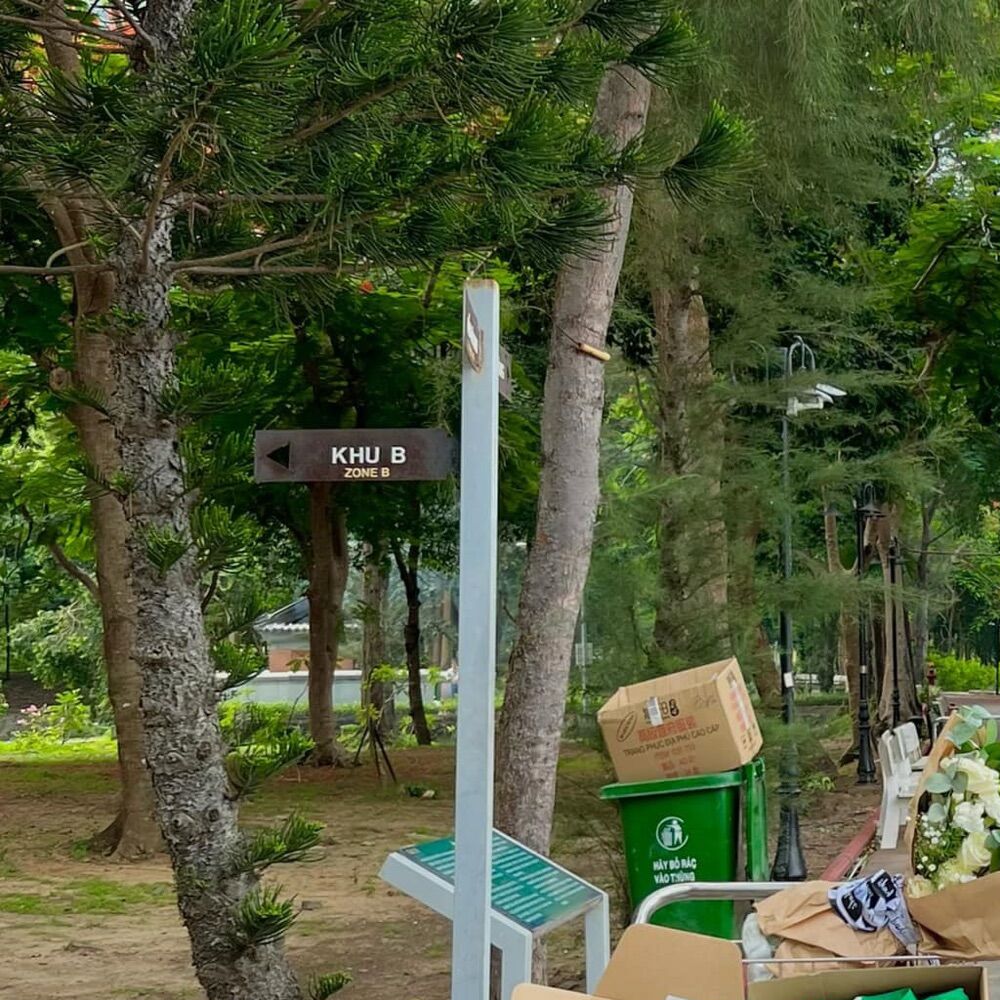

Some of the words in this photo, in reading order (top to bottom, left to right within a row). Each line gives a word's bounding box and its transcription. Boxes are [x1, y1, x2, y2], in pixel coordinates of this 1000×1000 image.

[331, 446, 380, 464] KHU
[391, 446, 406, 464] B
[344, 468, 379, 478] ZONE
[381, 467, 391, 477] B
